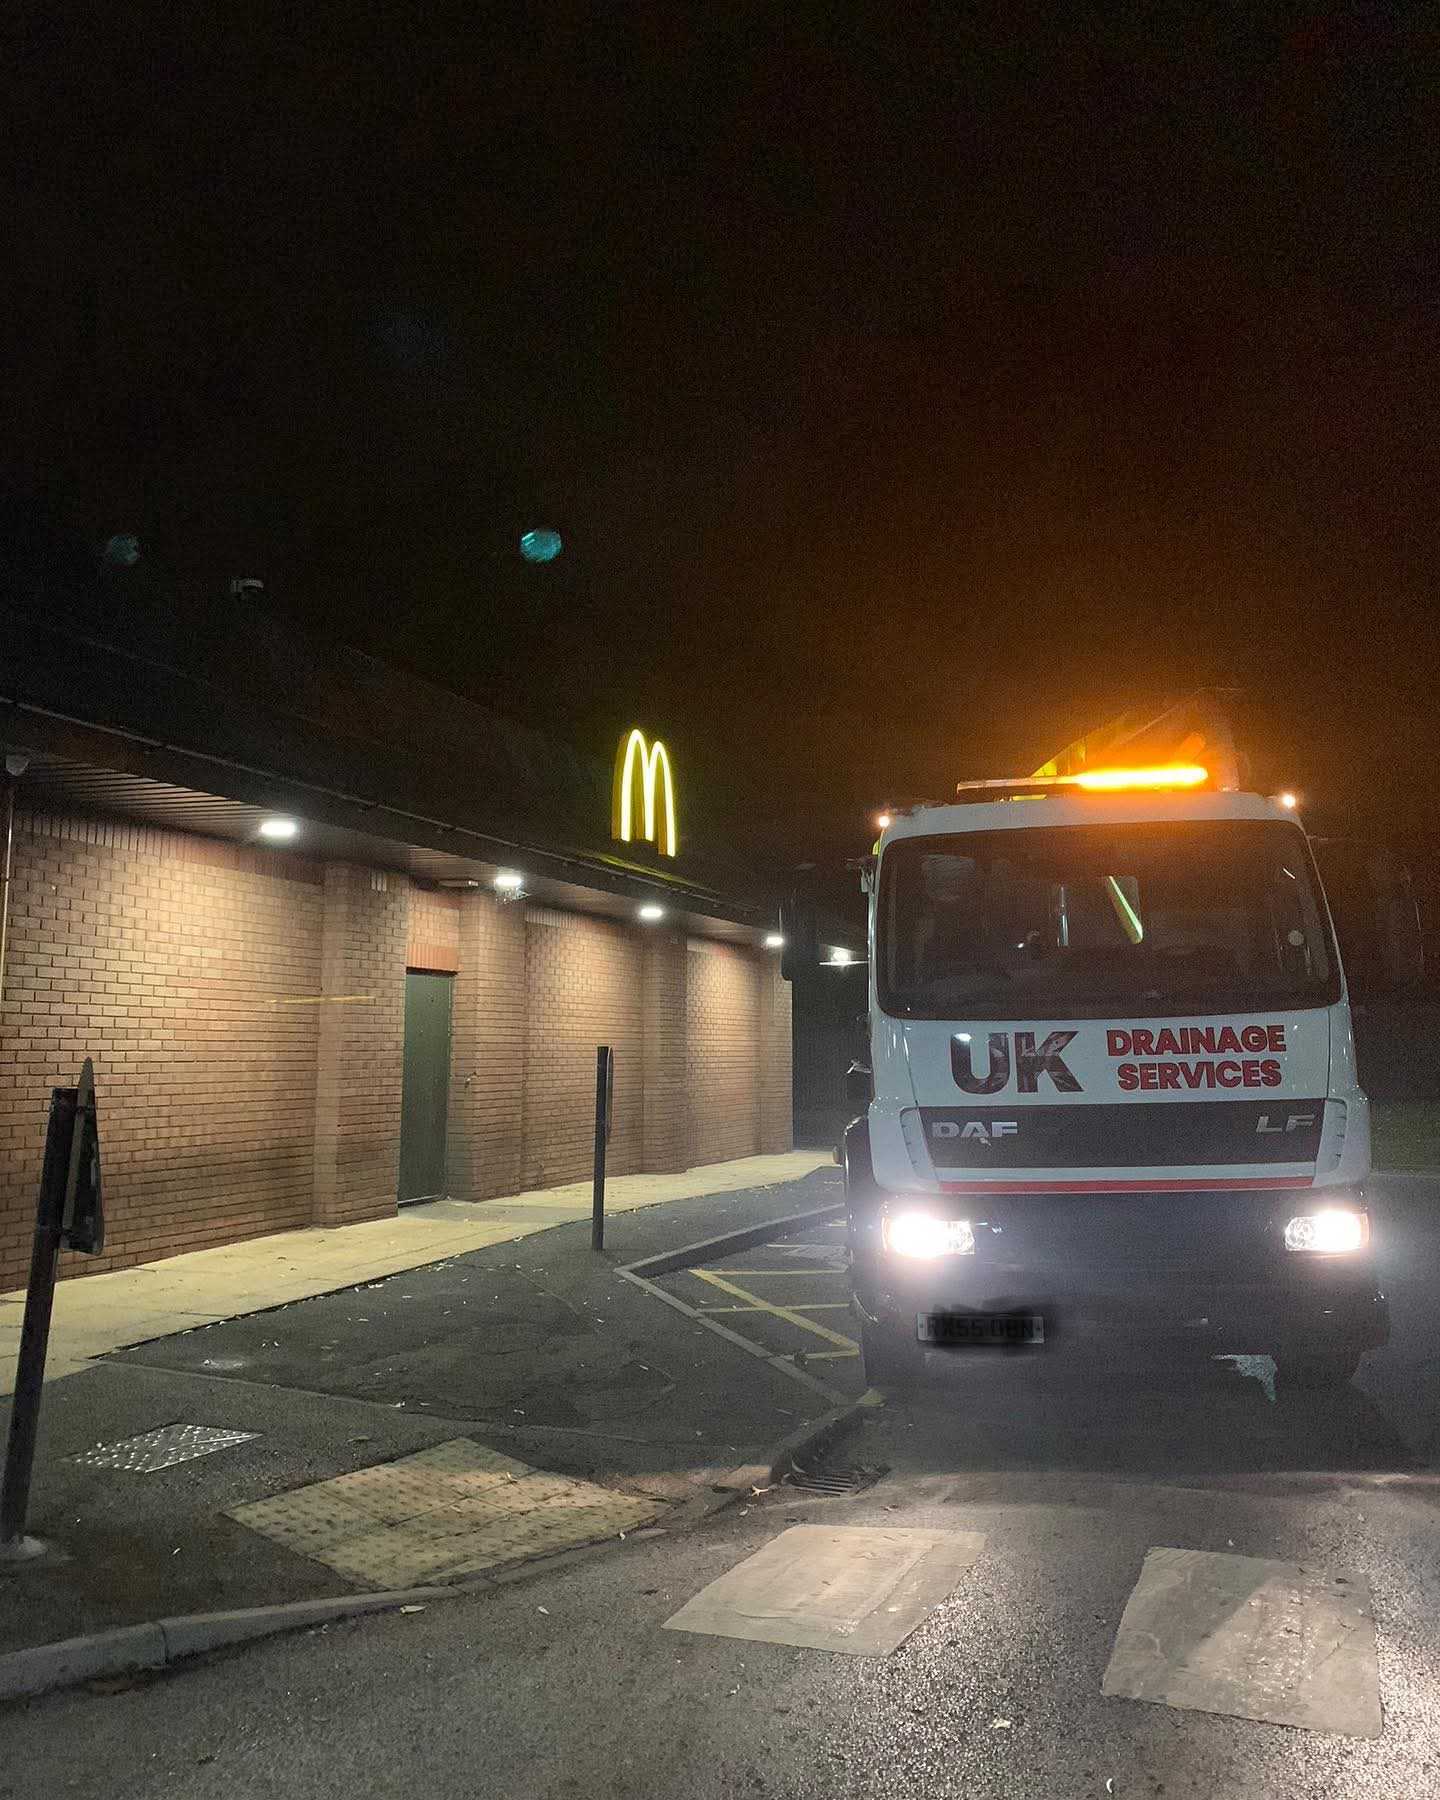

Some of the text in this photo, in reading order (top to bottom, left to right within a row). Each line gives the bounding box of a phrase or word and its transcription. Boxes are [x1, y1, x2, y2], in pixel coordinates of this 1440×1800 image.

[1107, 1025, 1287, 1056] DRAINAGE
[951, 1030, 1085, 1095] UK
[1117, 1059, 1282, 1091] SERVICES
[931, 1121, 1018, 1138] DAF
[1256, 1114, 1314, 1133] LF
